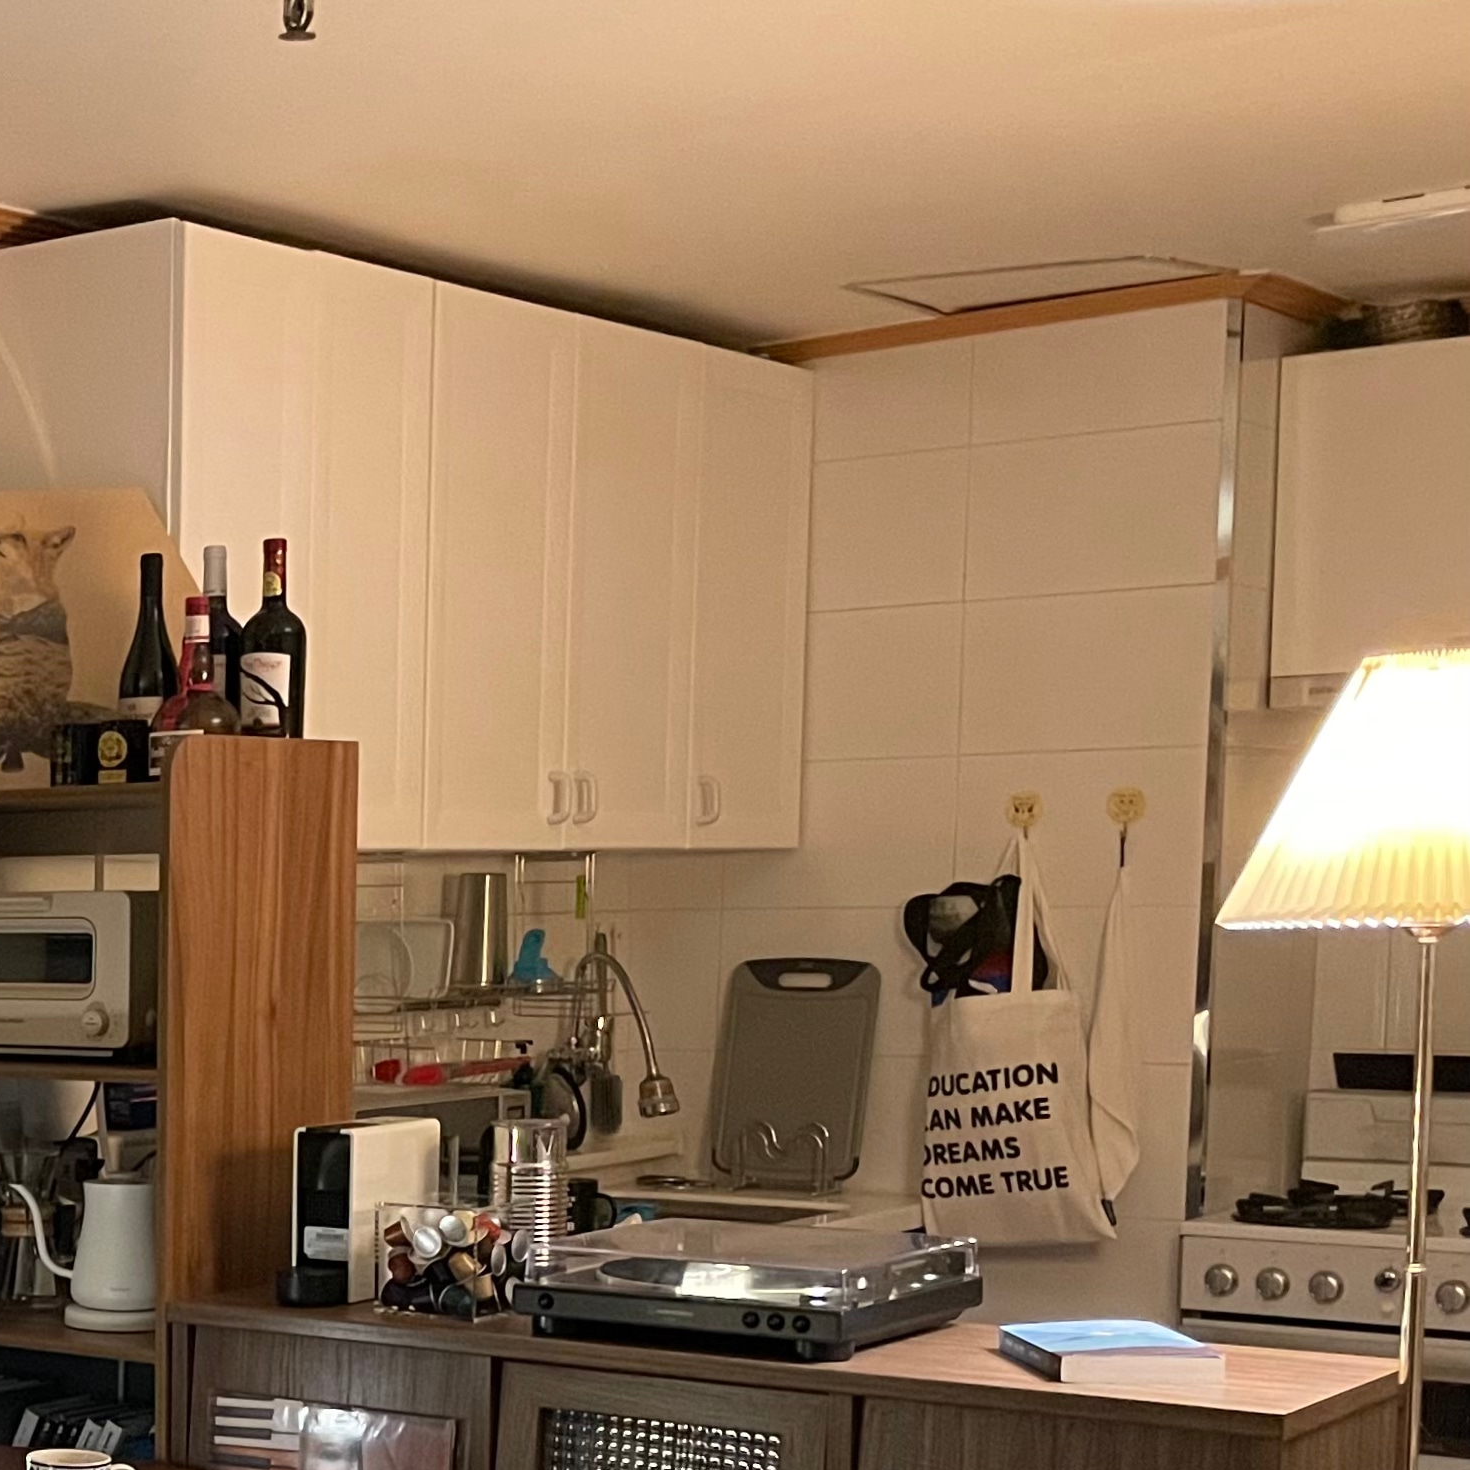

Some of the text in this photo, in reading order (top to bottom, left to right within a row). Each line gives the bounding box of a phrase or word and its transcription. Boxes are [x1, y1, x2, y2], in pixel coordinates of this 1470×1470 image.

[928, 1062, 1059, 1098] DUCATION
[924, 1097, 1051, 1132] AN MAKE
[921, 1166, 1069, 1200] COME TRUE
